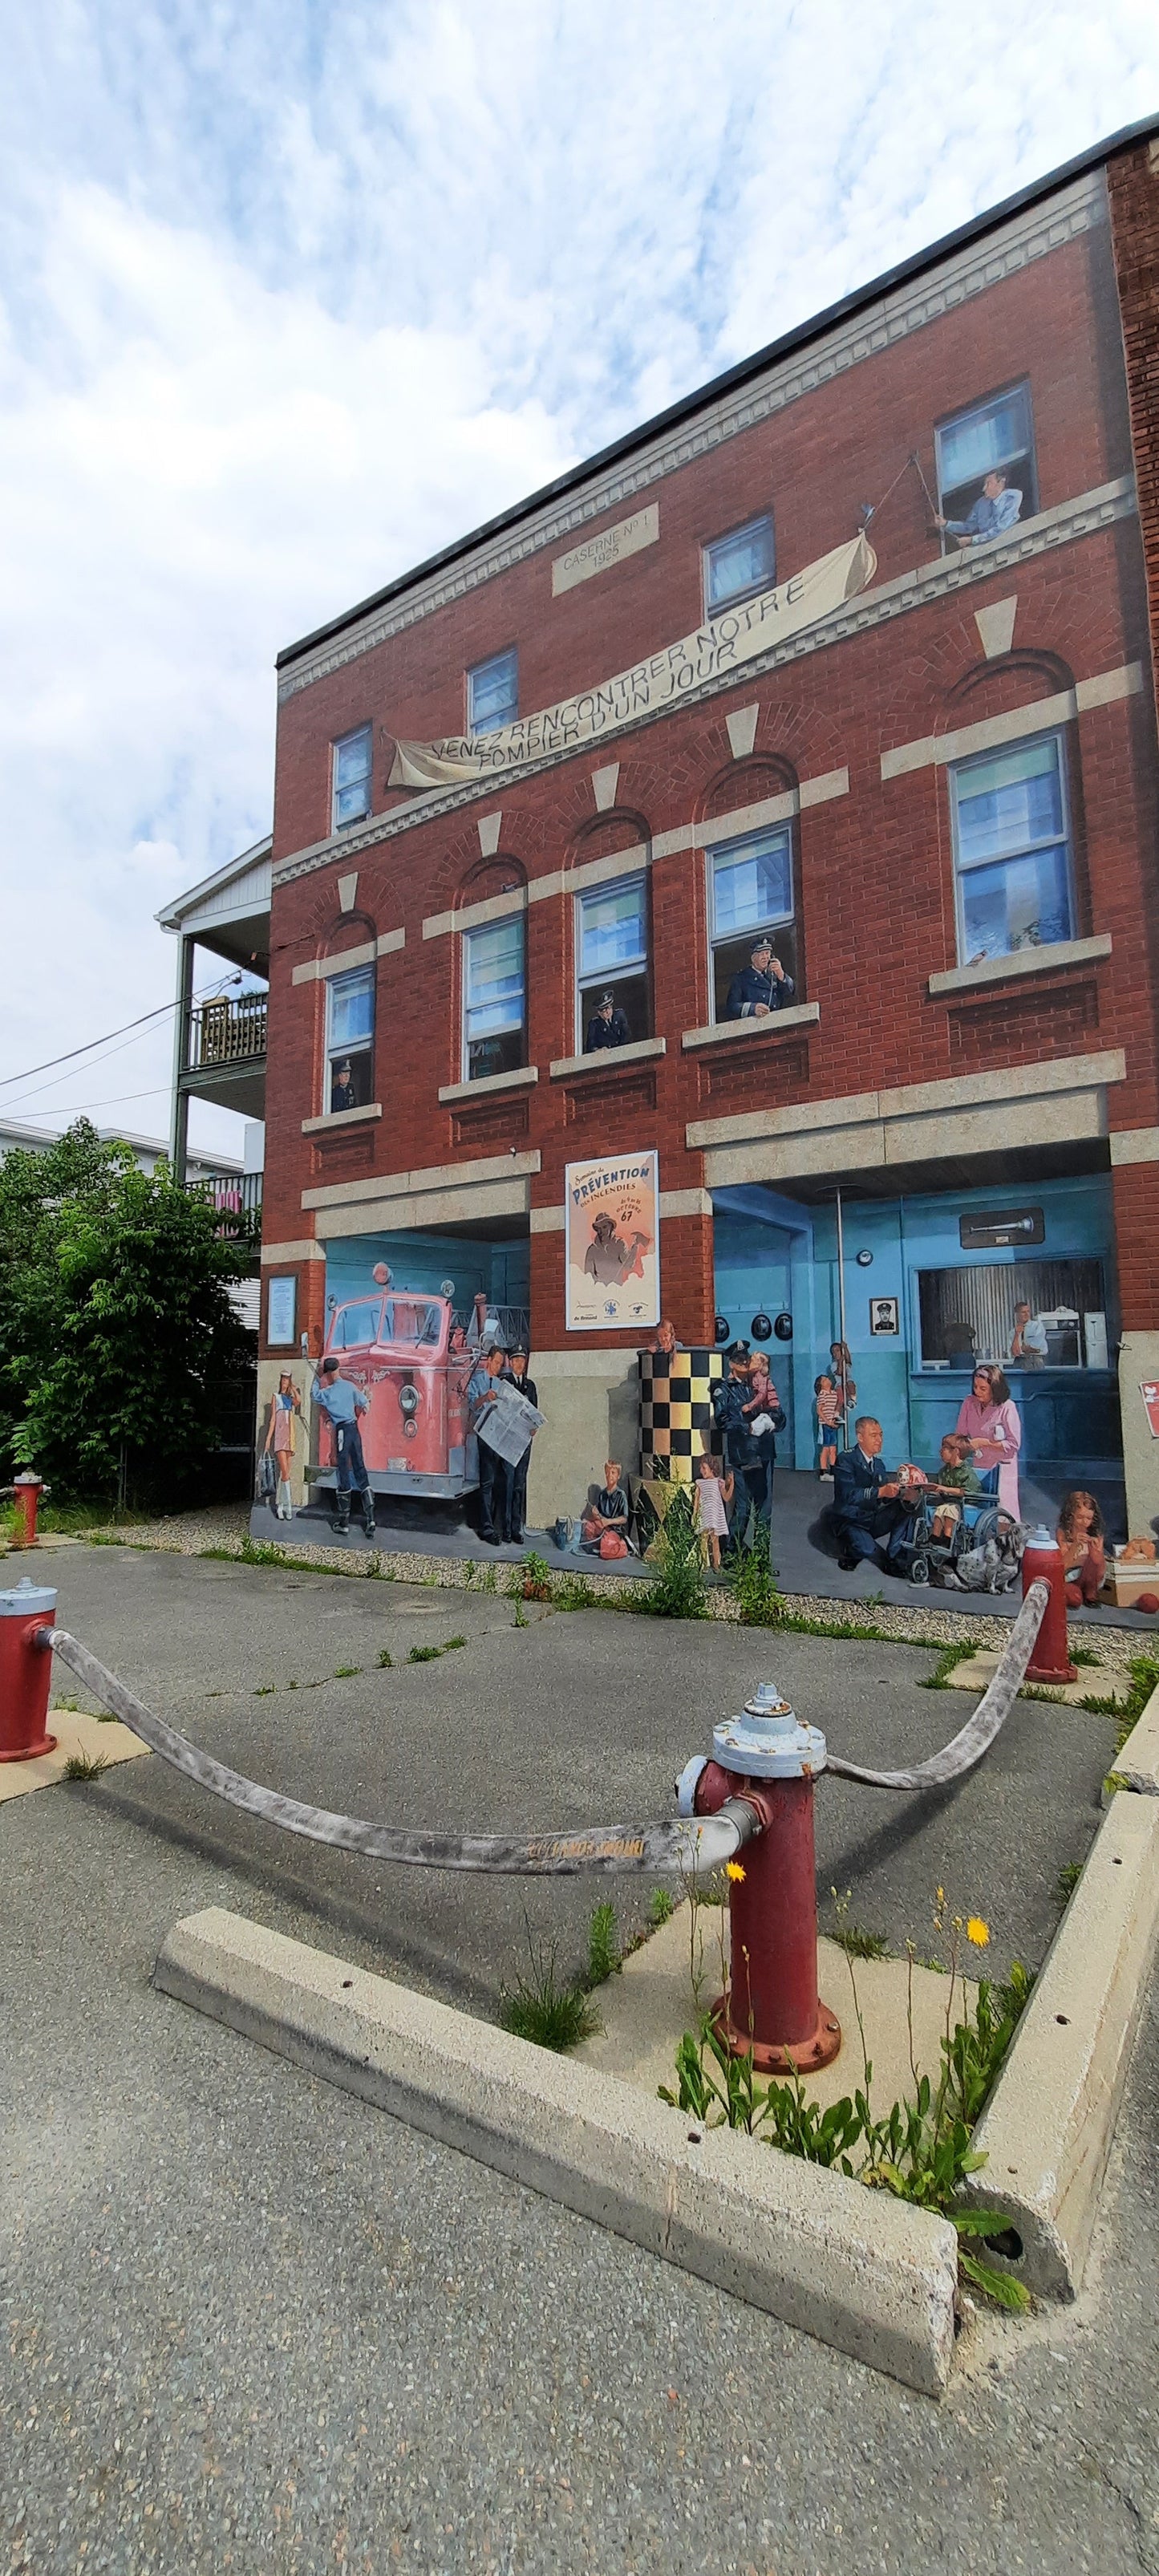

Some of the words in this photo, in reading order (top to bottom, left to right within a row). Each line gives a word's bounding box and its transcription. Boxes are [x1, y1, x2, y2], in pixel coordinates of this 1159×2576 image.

[564, 530, 620, 570] CASERNE
[643, 515, 647, 525] 1
[594, 543, 619, 567] 1925
[432, 731, 503, 760] VENEZ
[510, 644, 687, 740] RENCONTRER
[696, 576, 804, 653] NOTRE
[478, 722, 579, 771] POMPIER
[591, 685, 650, 732] D'UN
[661, 641, 737, 699] JOUR
[573, 1168, 650, 1205] PRÉVENTION
[575, 1170, 596, 1186] Semaine
[590, 1183, 636, 1202] INCENDIES
[621, 1211, 633, 1222] 67
